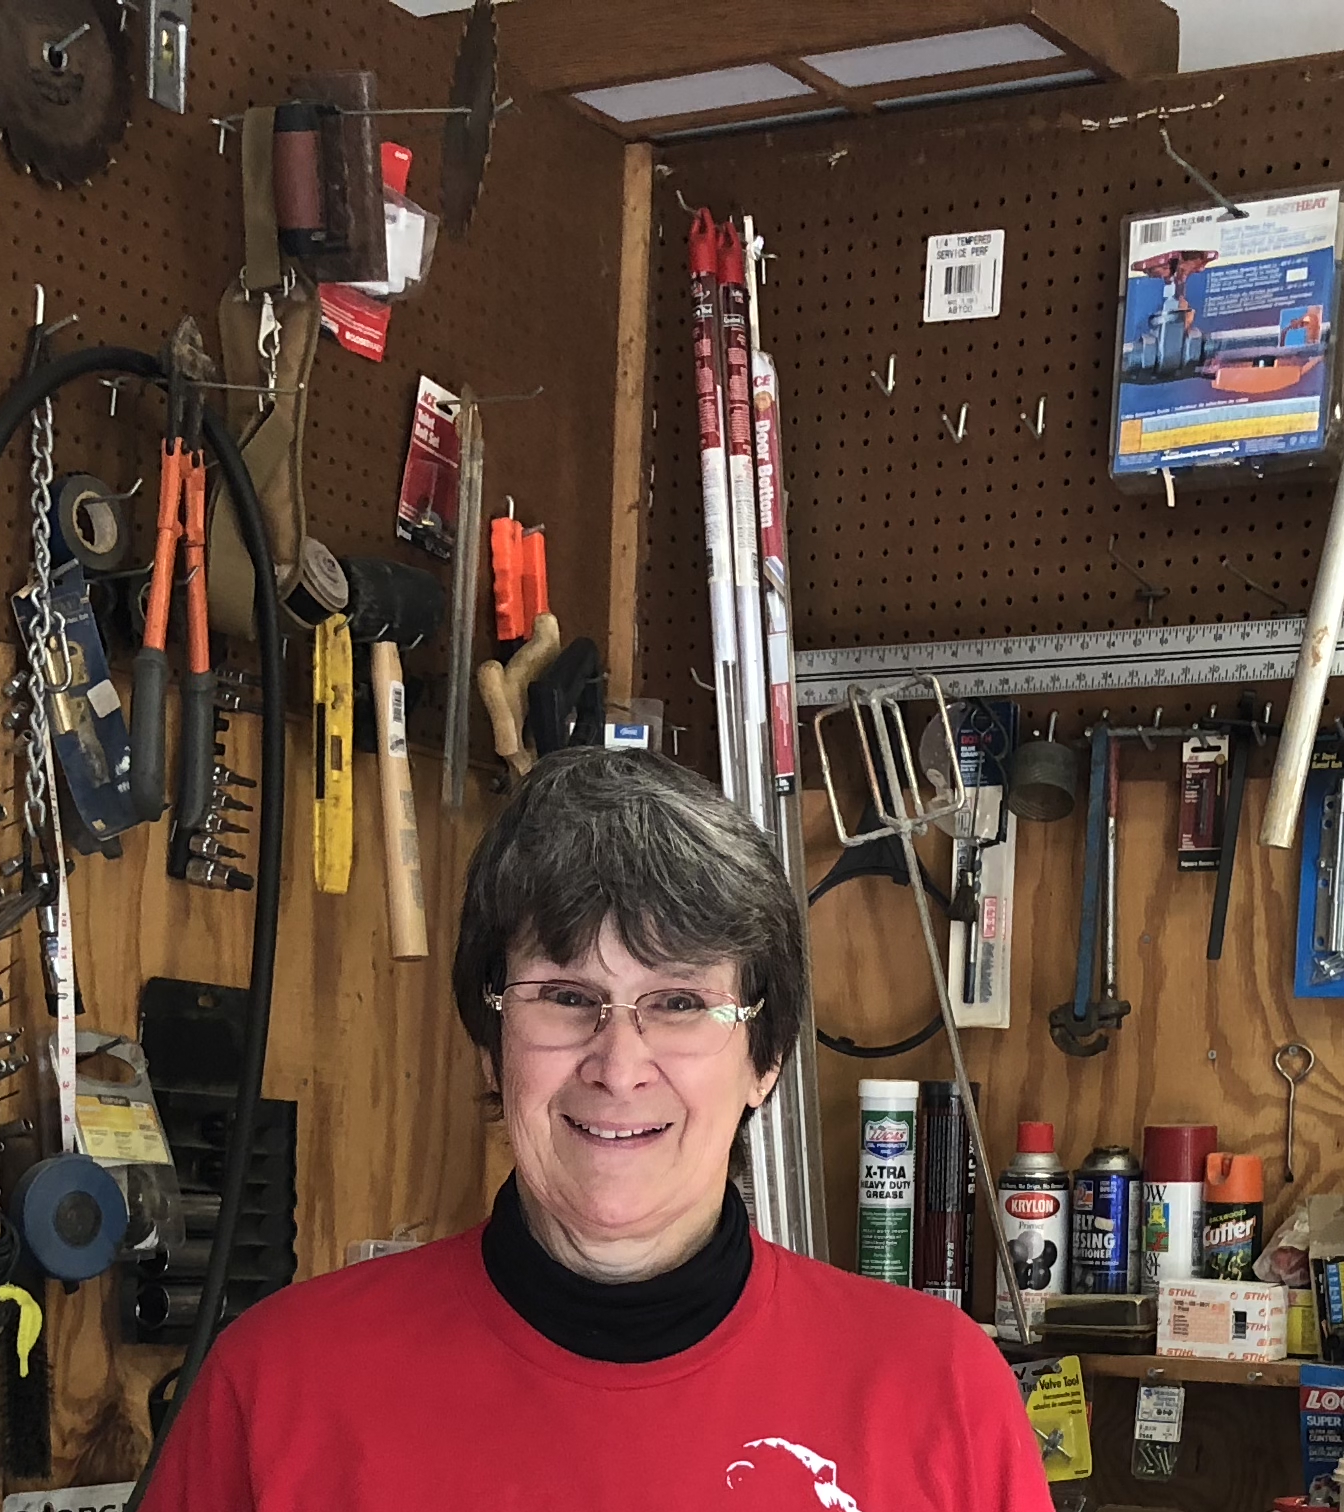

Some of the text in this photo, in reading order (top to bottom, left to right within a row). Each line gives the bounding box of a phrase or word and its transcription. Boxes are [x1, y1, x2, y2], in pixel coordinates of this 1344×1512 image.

[936, 248, 967, 260] SERVICE
[752, 375, 771, 387] CE
[756, 420, 774, 528] Door Bottom
[869, 1130, 906, 1142] LUCAS
[864, 1165, 907, 1179] X-TRA
[861, 1180, 911, 1190] HEAVY DUTY
[865, 1190, 904, 1200] GREASE
[1011, 1199, 1054, 1213] KRYLON
[1018, 1221, 1045, 1230] Primer
[1203, 1216, 1256, 1246] Cutter
[1168, 1288, 1198, 1297] STIHL
[1167, 1348, 1198, 1357] STIHL
[1022, 1375, 1080, 1393] Tire Valve Tool
[1306, 1415, 1342, 1427] SUPER
